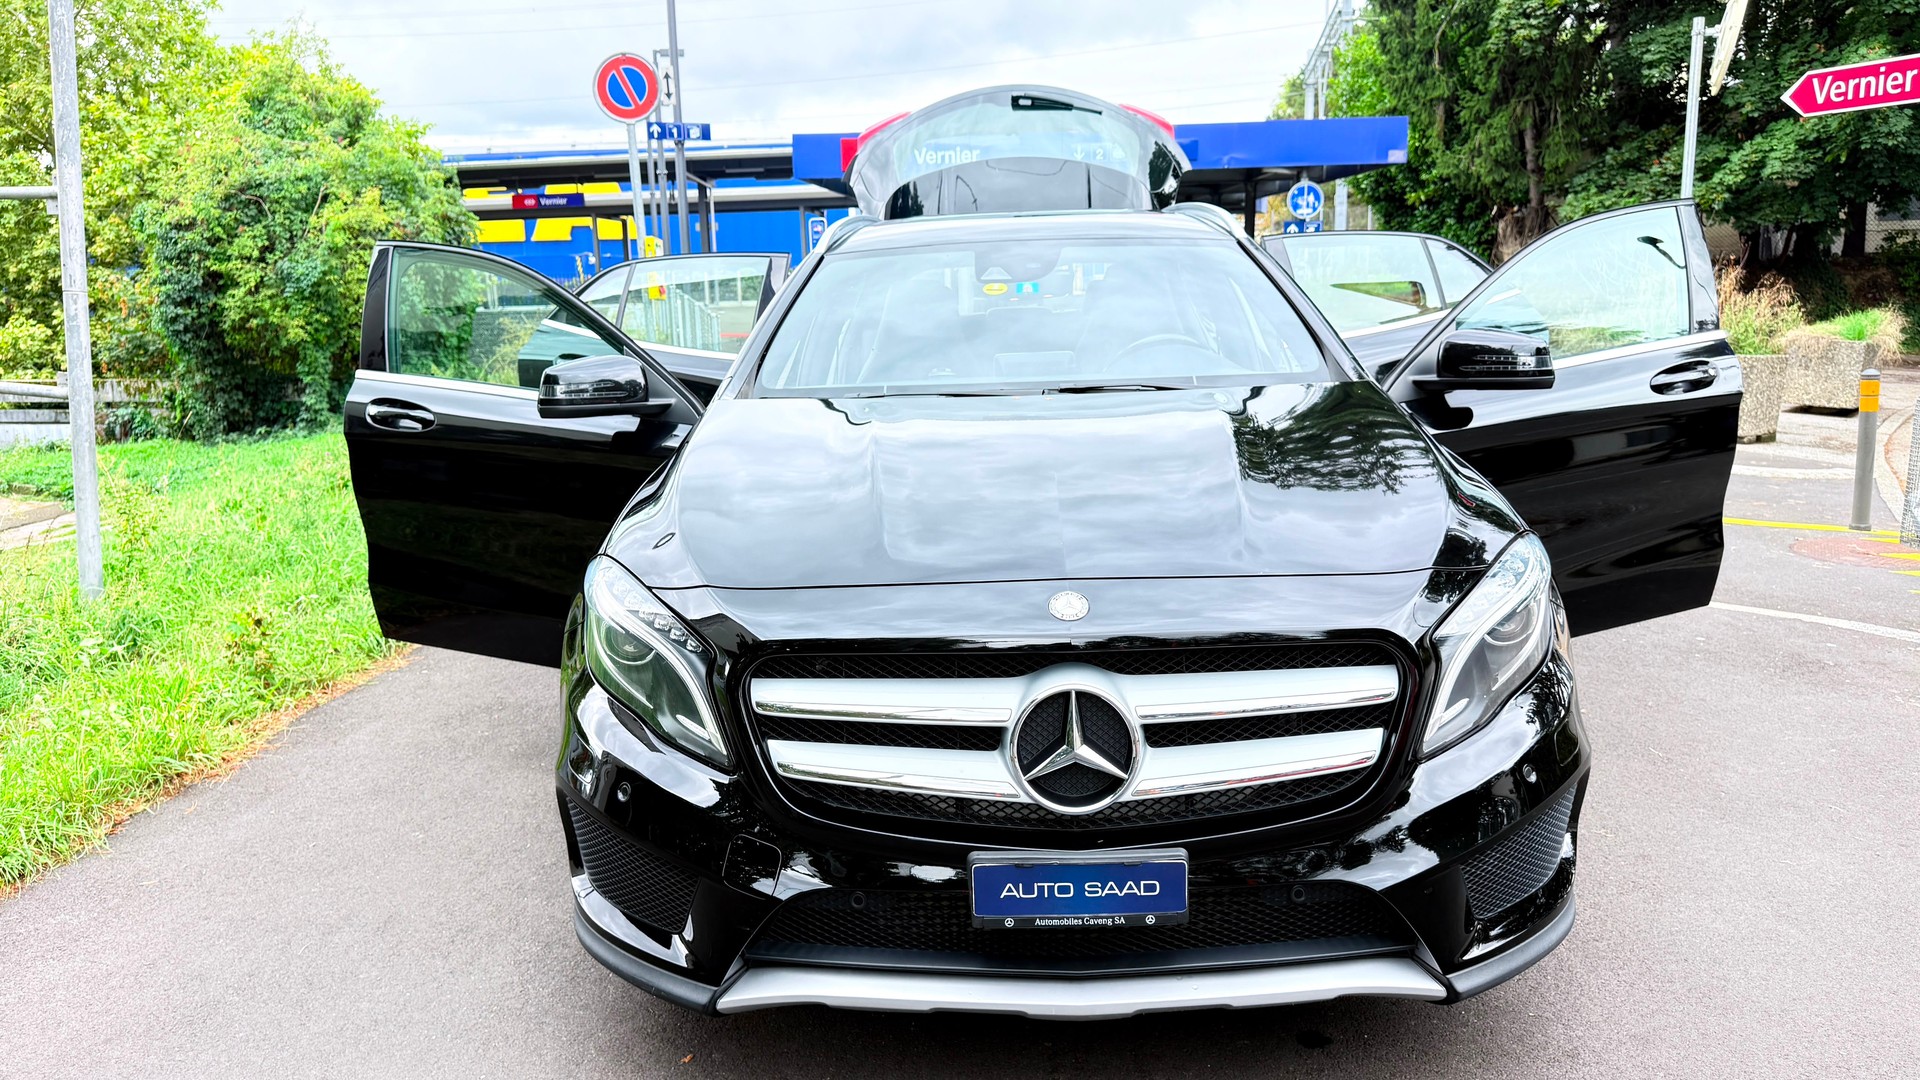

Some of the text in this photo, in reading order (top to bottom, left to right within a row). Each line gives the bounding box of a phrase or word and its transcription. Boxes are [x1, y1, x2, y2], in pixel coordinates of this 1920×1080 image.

[1812, 66, 1918, 105] Vernier
[913, 146, 1104, 165] Vernier 2
[539, 196, 568, 206] Vernier
[1000, 880, 1160, 899] AUTO SAAD
[1034, 917, 1083, 926] Automobiles
[1114, 916, 1126, 924] SA
